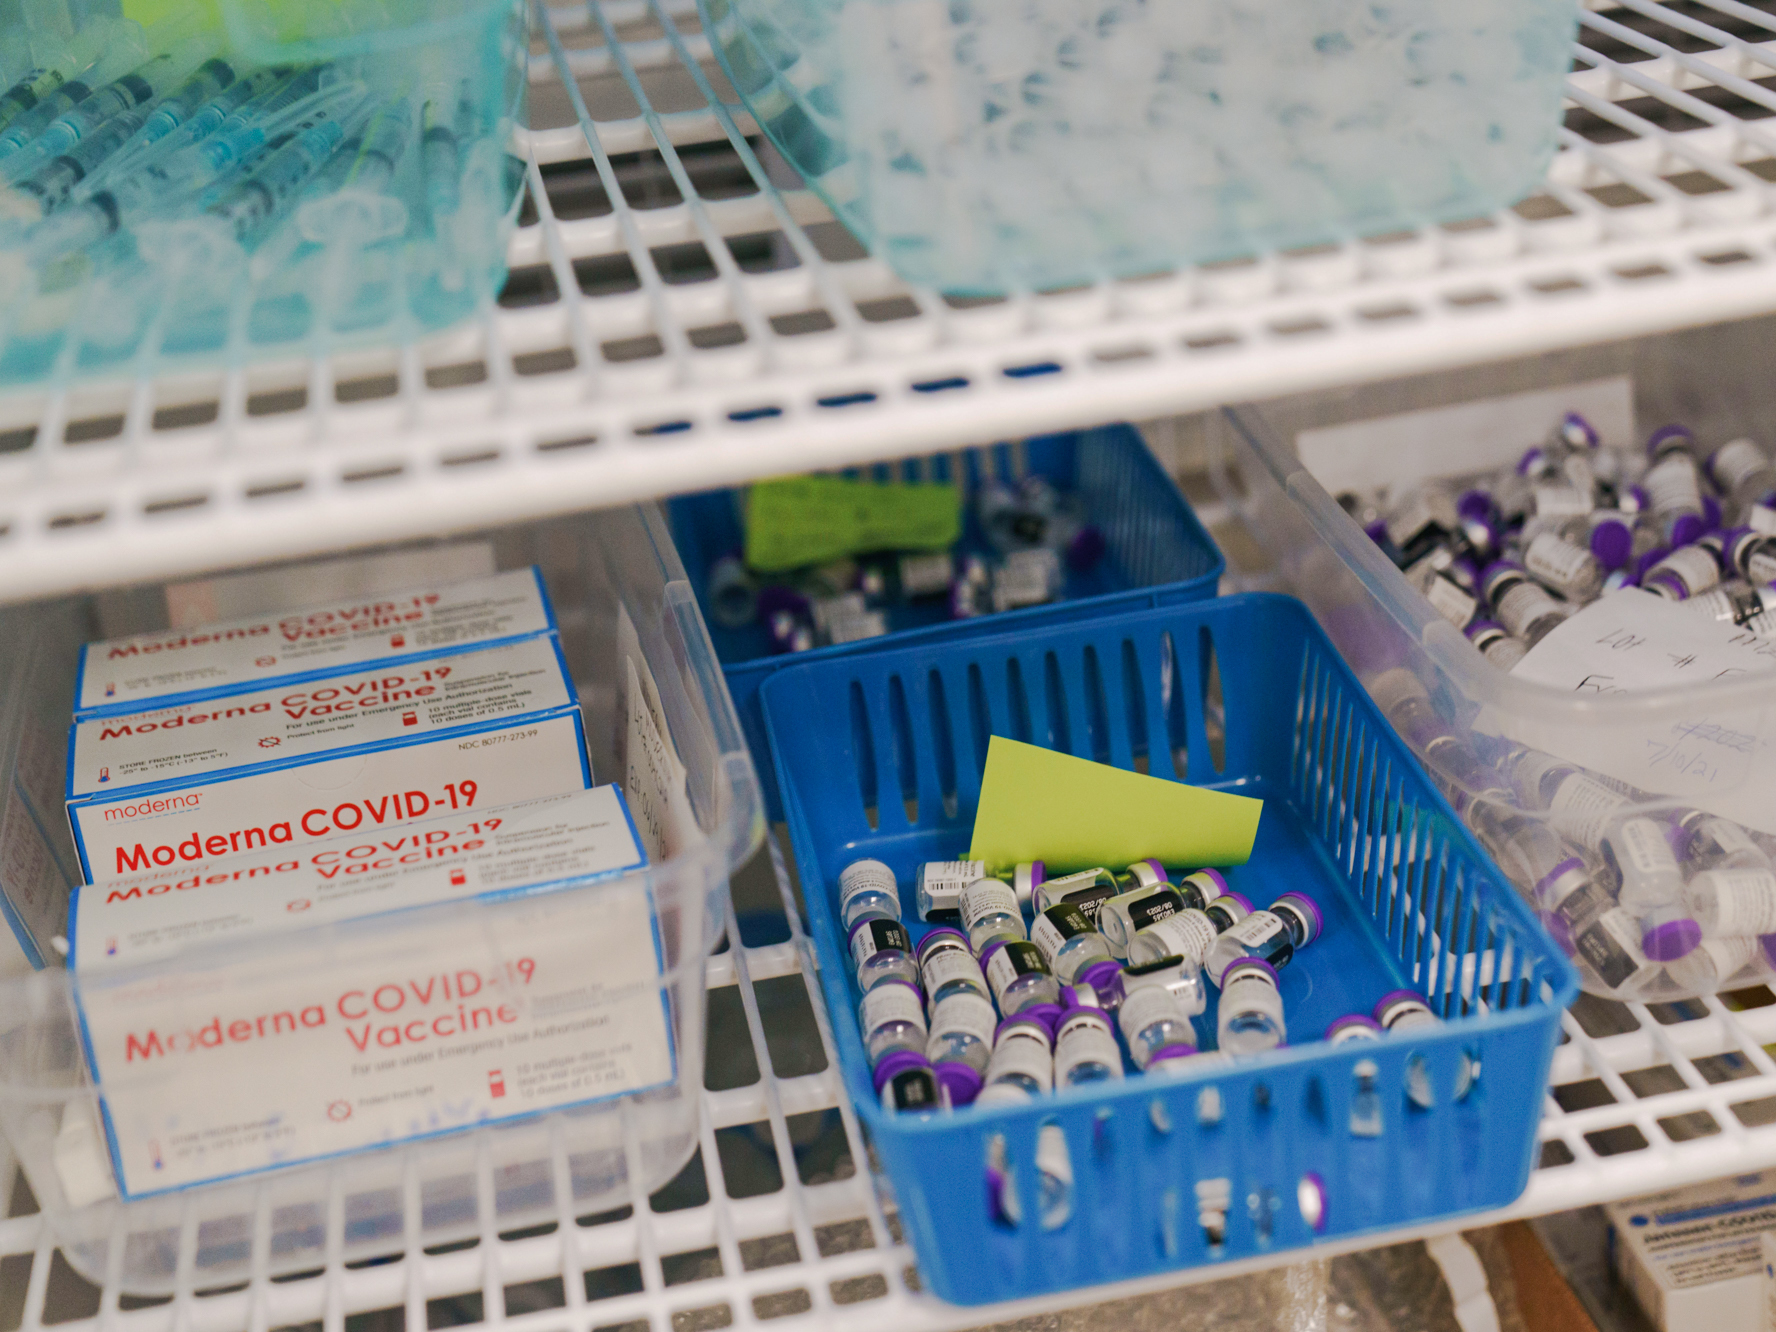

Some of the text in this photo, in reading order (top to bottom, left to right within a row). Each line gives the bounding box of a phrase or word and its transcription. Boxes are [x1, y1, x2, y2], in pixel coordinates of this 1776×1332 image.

[109, 625, 270, 660] Moderna
[100, 666, 452, 741] Moderna COVID-19
[284, 685, 437, 720] Vaccine
[306, 719, 325, 727] use
[328, 713, 358, 723] under
[362, 701, 420, 716] Emergency
[422, 696, 443, 705] Use
[445, 683, 513, 701] Authorization
[428, 706, 441, 714] 10
[510, 689, 532, 698] vials
[428, 698, 517, 719] (each vial contains
[430, 717, 443, 725] 10
[445, 712, 474, 722] doses
[488, 706, 504, 714] 0.5
[287, 730, 315, 739] Protect
[337, 723, 355, 731] light
[458, 729, 538, 750] NDC 80777-273-99
[119, 748, 218, 770] STORE FROZEN between
[104, 793, 200, 821] moderna
[115, 779, 478, 874] Moderna COVID-19
[106, 818, 503, 904] Moderna COVID-19
[316, 839, 485, 879] Vaccine
[125, 1004, 327, 1063] Moderna
[337, 957, 536, 1020] COVID-19
[345, 1004, 519, 1052] Vaccine
[437, 1037, 504, 1060] Emergency
[532, 1014, 610, 1039] Authorization
